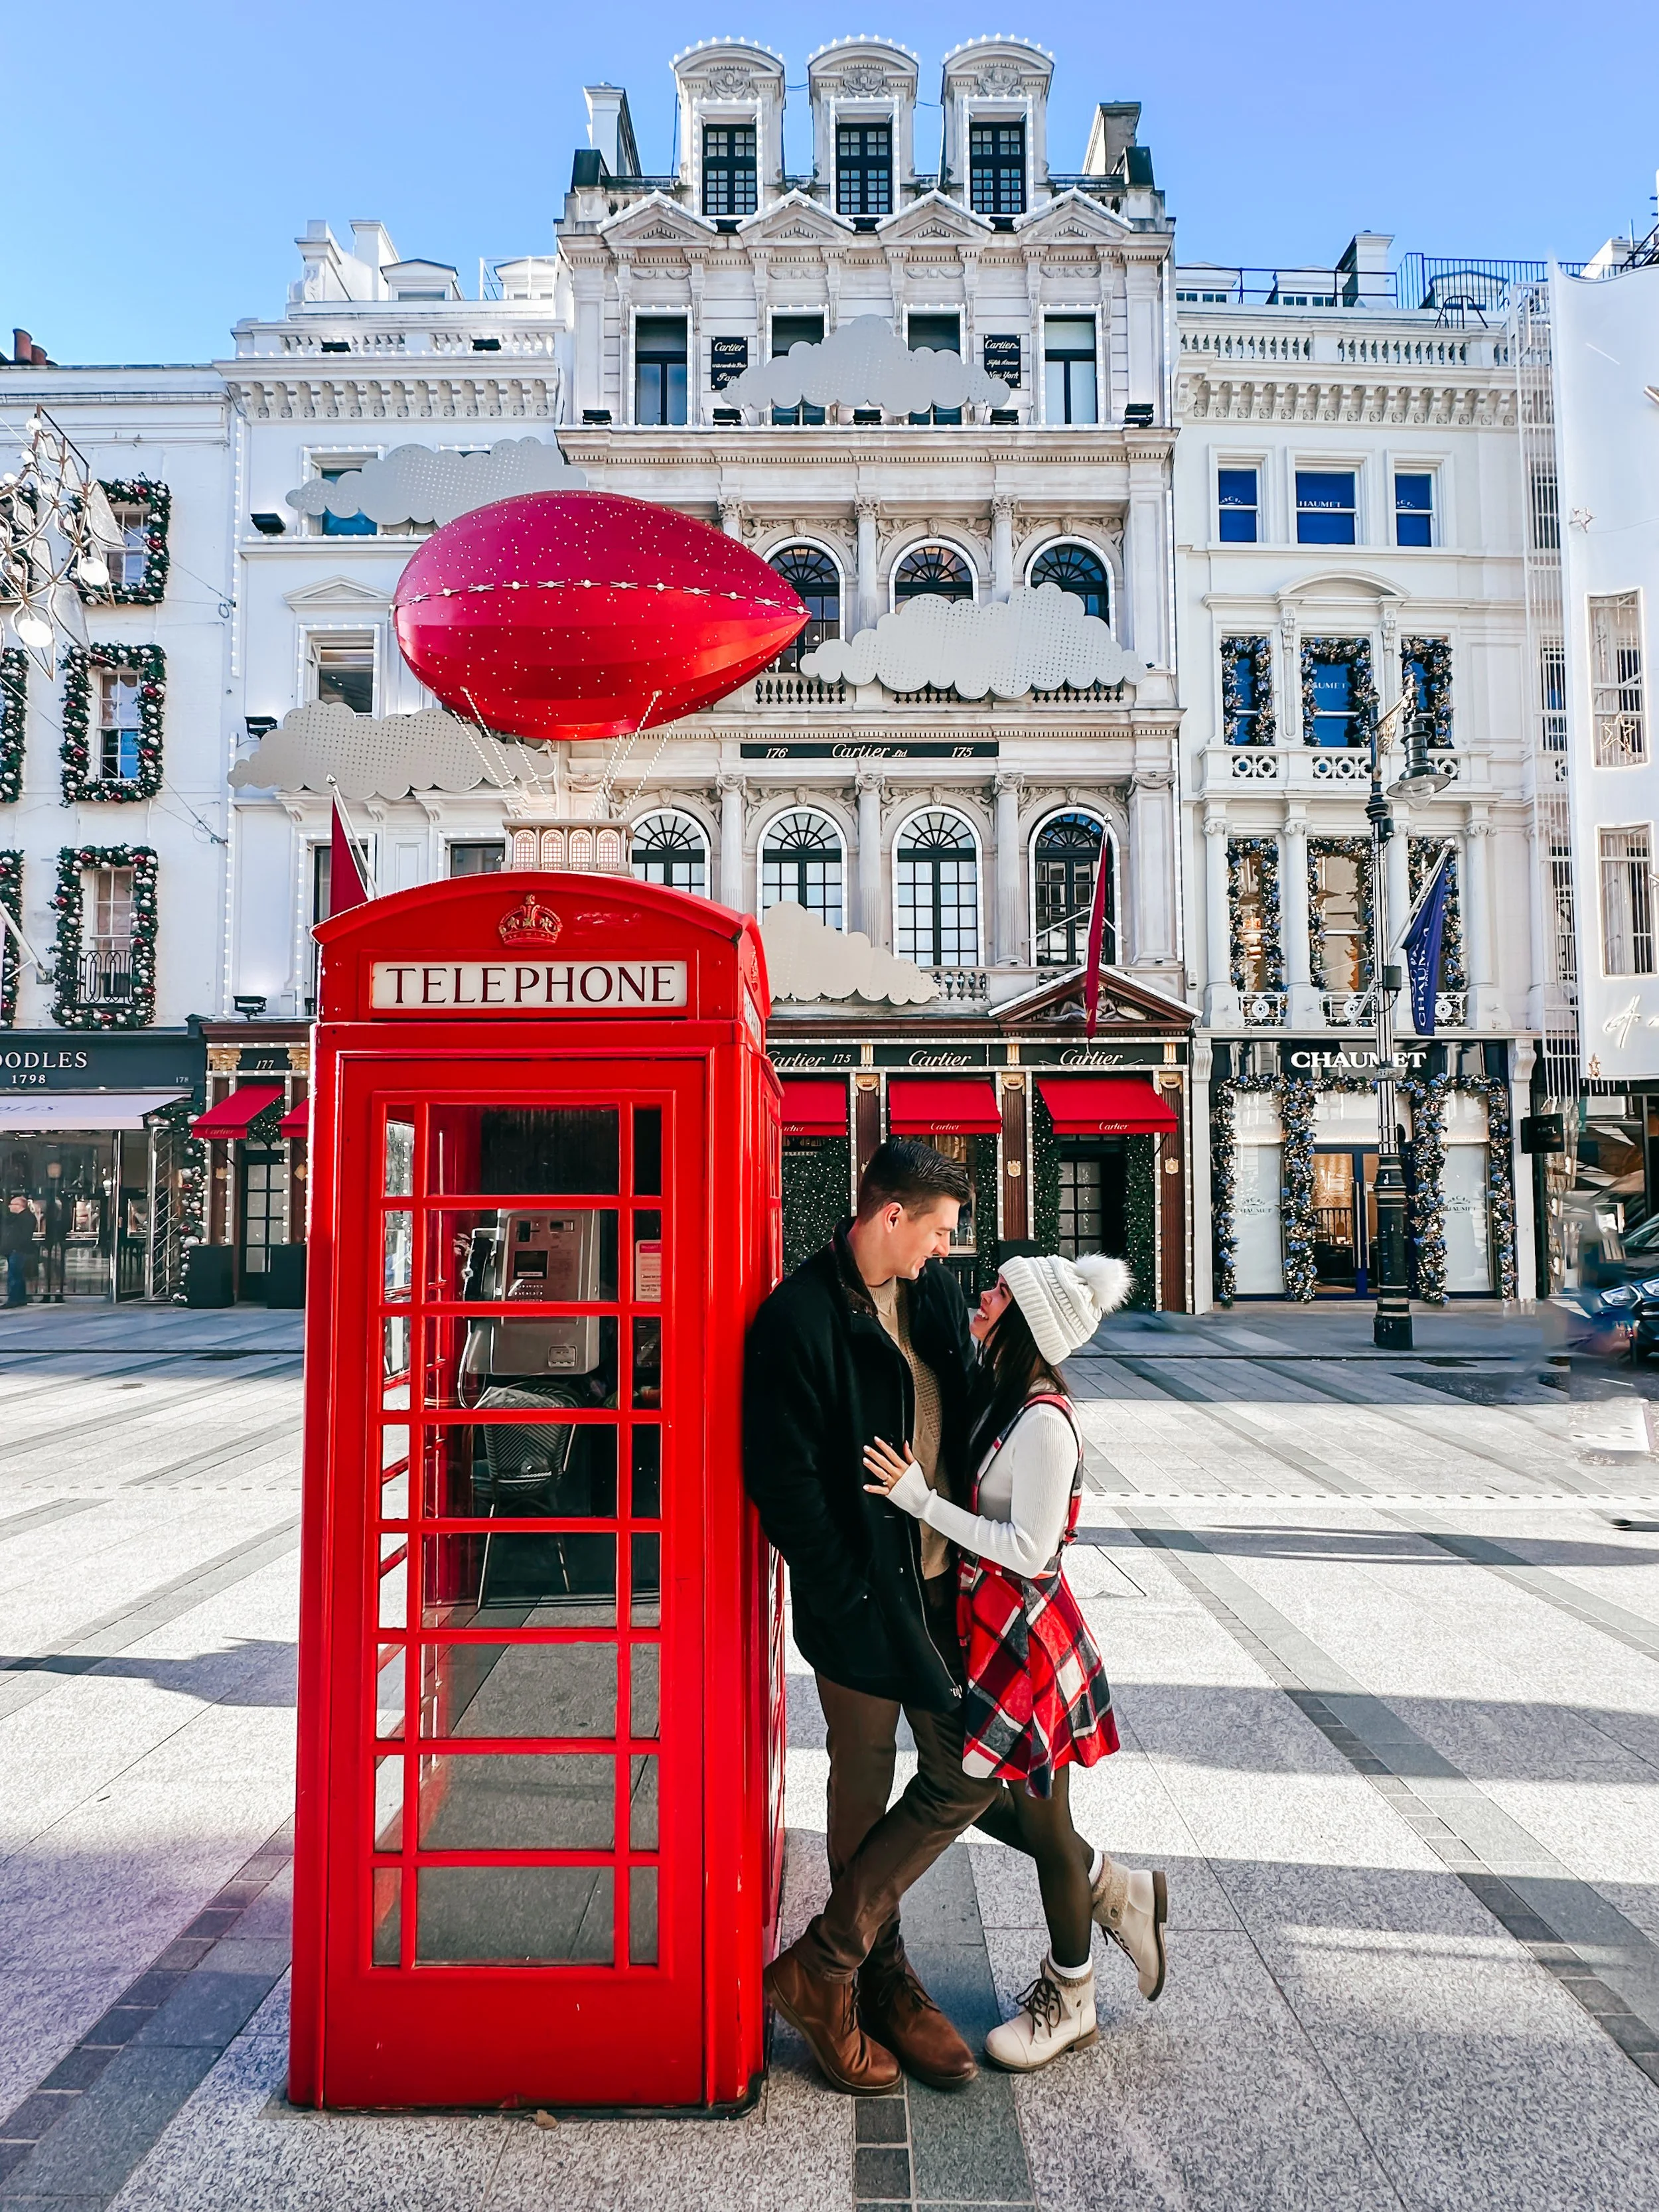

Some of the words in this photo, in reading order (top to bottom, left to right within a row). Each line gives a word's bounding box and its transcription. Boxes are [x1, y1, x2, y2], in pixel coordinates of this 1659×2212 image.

[714, 342, 745, 352] Cartier
[985, 339, 1014, 349] Cartier
[717, 372, 737, 382] Par
[1003, 371, 1019, 381] York
[765, 747, 788, 758] 176
[832, 743, 890, 758] Cartier
[951, 747, 974, 757] 175
[386, 966, 676, 1003] TELEPHONE
[0, 1051, 88, 1069] ODLES
[831, 1054, 851, 1063] 175
[908, 1049, 972, 1067] Cartier
[1060, 1049, 1123, 1065] Cartier
[255, 1060, 275, 1069] 177
[11, 1074, 46, 1084] 1798
[930, 1122, 961, 1131] Cartier
[1099, 1122, 1129, 1130] Cartier
